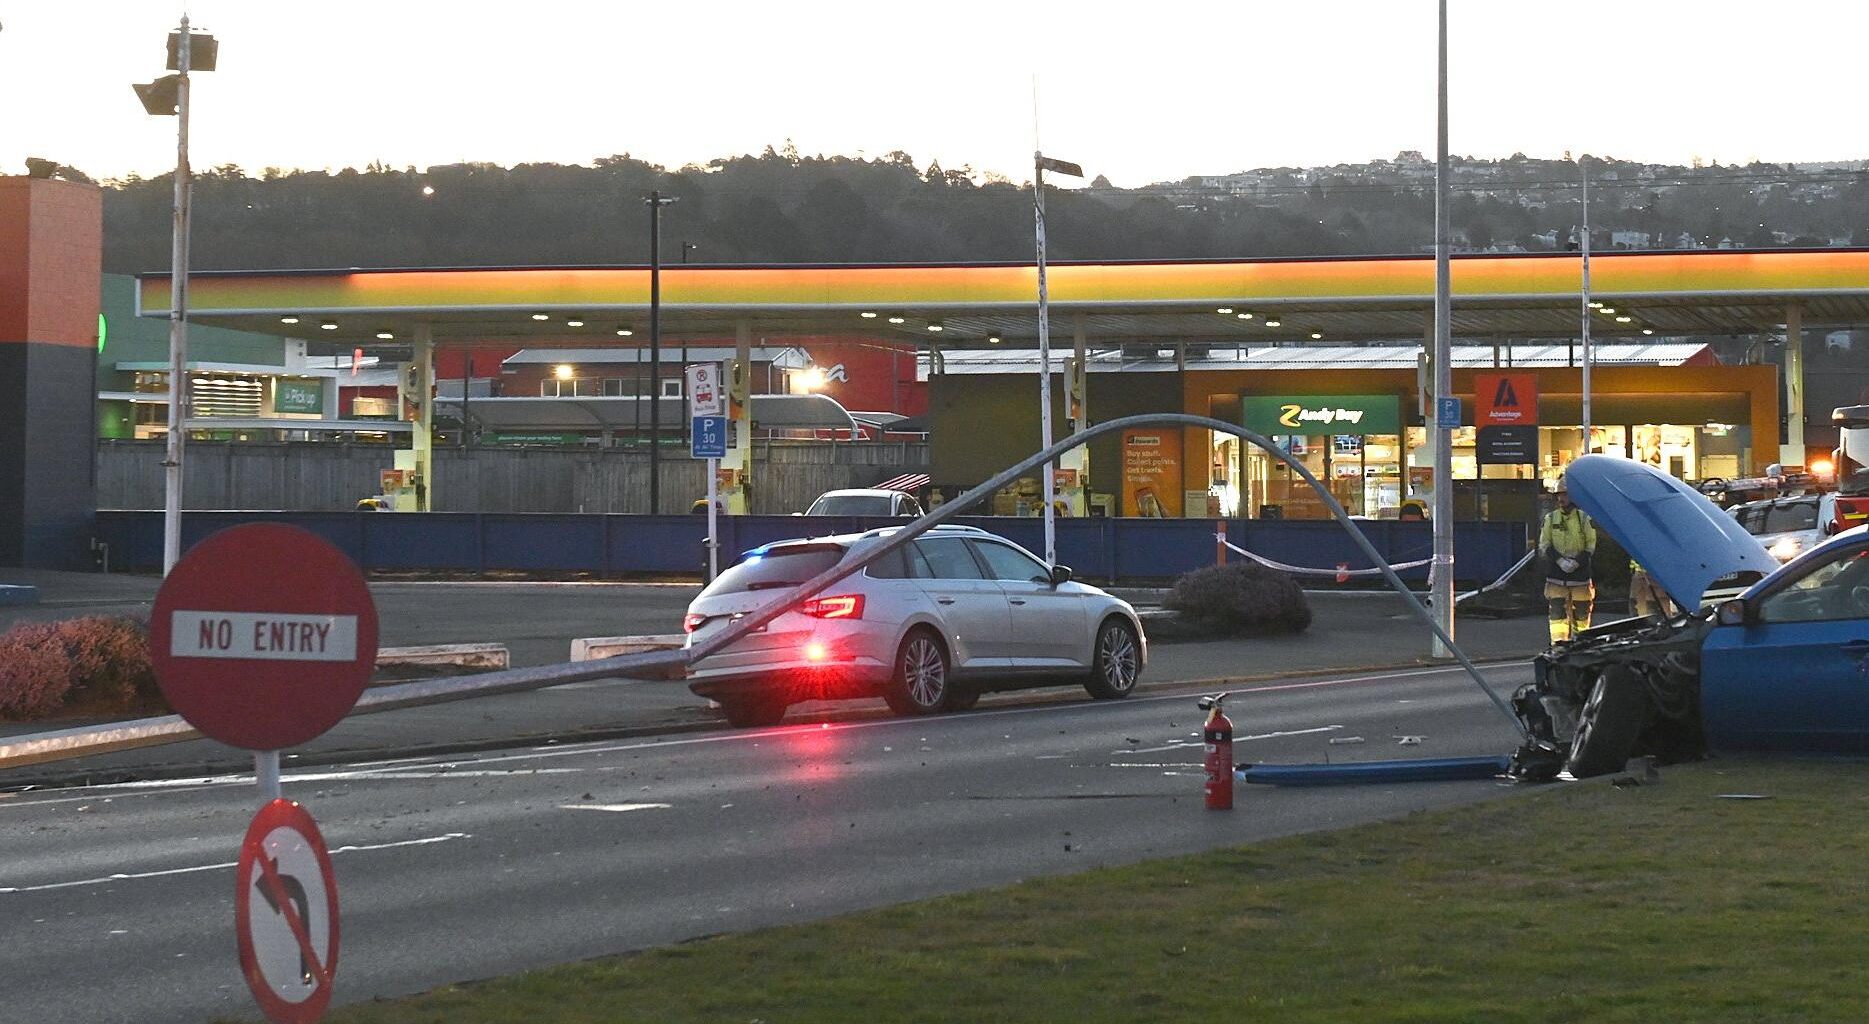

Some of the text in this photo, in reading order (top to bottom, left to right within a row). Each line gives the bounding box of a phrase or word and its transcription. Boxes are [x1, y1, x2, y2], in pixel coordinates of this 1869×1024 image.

[1445, 400, 1453, 410] P
[1298, 407, 1336, 424] Andy
[703, 419, 714, 432] P
[702, 433, 716, 443] 30
[199, 618, 331, 653] NO ENTRY
